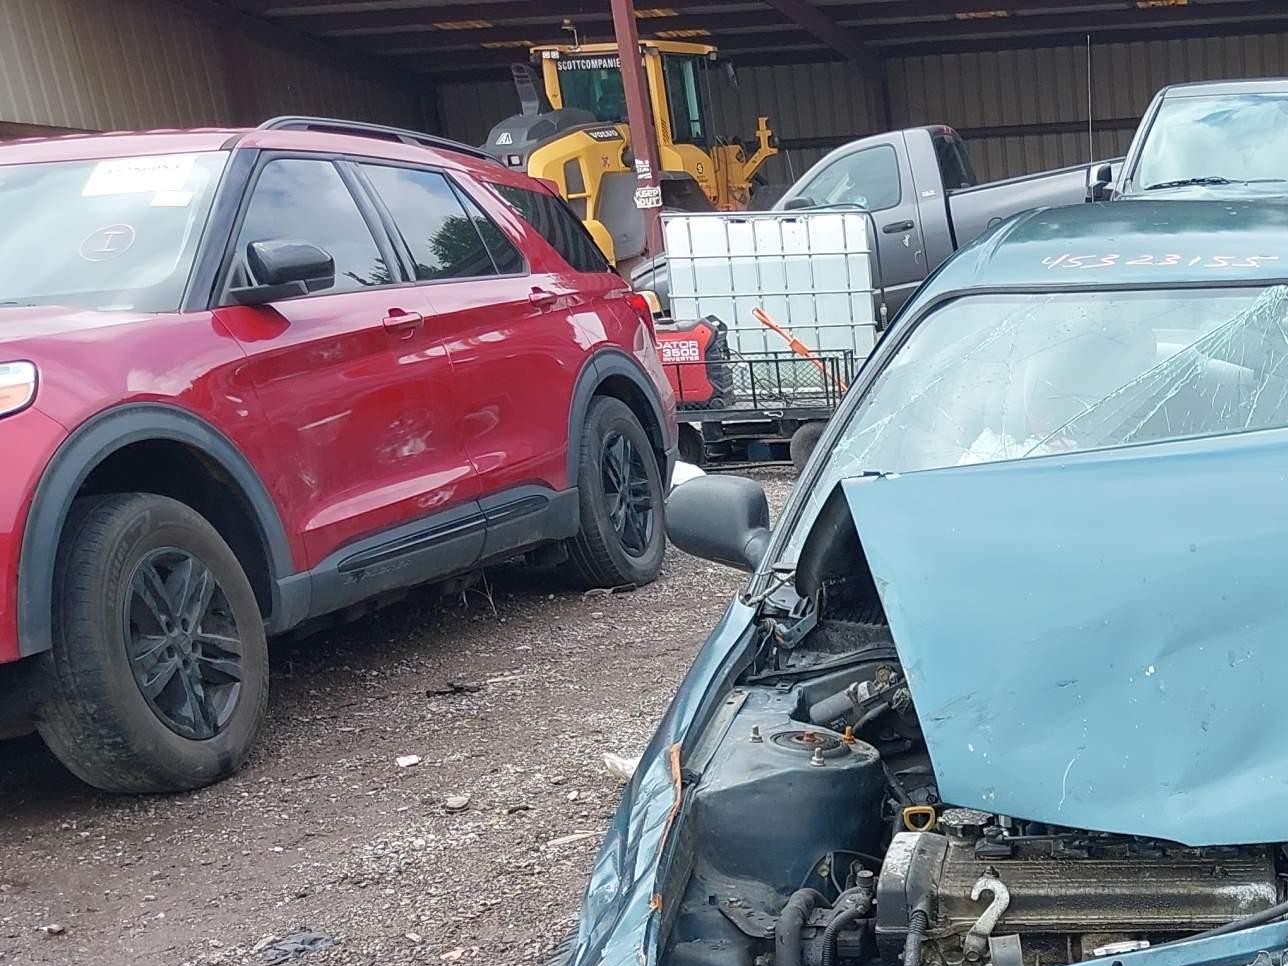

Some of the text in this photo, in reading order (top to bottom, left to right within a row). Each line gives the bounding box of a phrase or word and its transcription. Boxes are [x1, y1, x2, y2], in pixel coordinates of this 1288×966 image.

[557, 58, 621, 70] SCOTTCOMPANIE
[589, 130, 618, 139] VOLVO
[635, 189, 658, 198] KEEP
[1041, 253, 1280, 270] 45323155
[656, 341, 698, 349] DATOR
[662, 348, 698, 356] 3500
